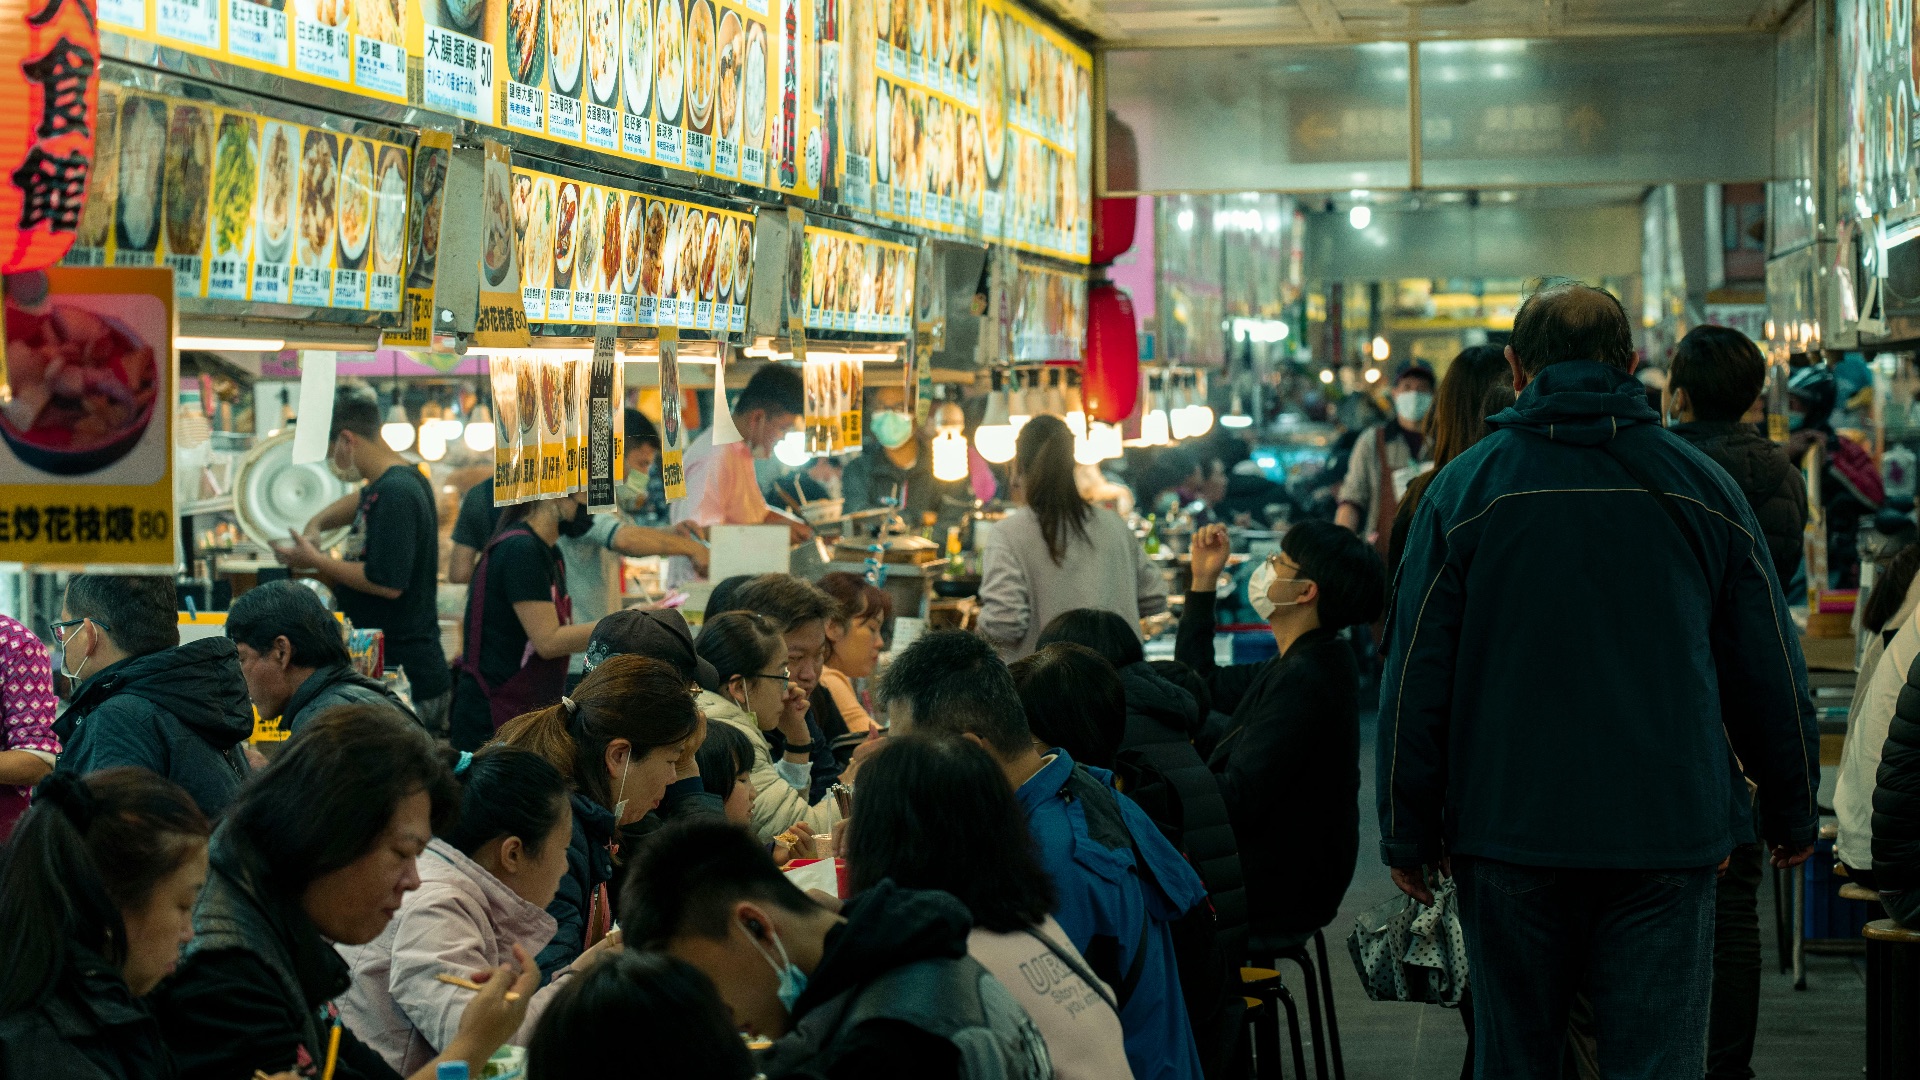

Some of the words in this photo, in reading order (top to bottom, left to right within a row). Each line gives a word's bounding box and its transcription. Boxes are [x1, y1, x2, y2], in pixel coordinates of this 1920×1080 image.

[427, 29, 477, 71] 大腸麵線
[481, 44, 492, 87] 50
[138, 510, 168, 541] 80
